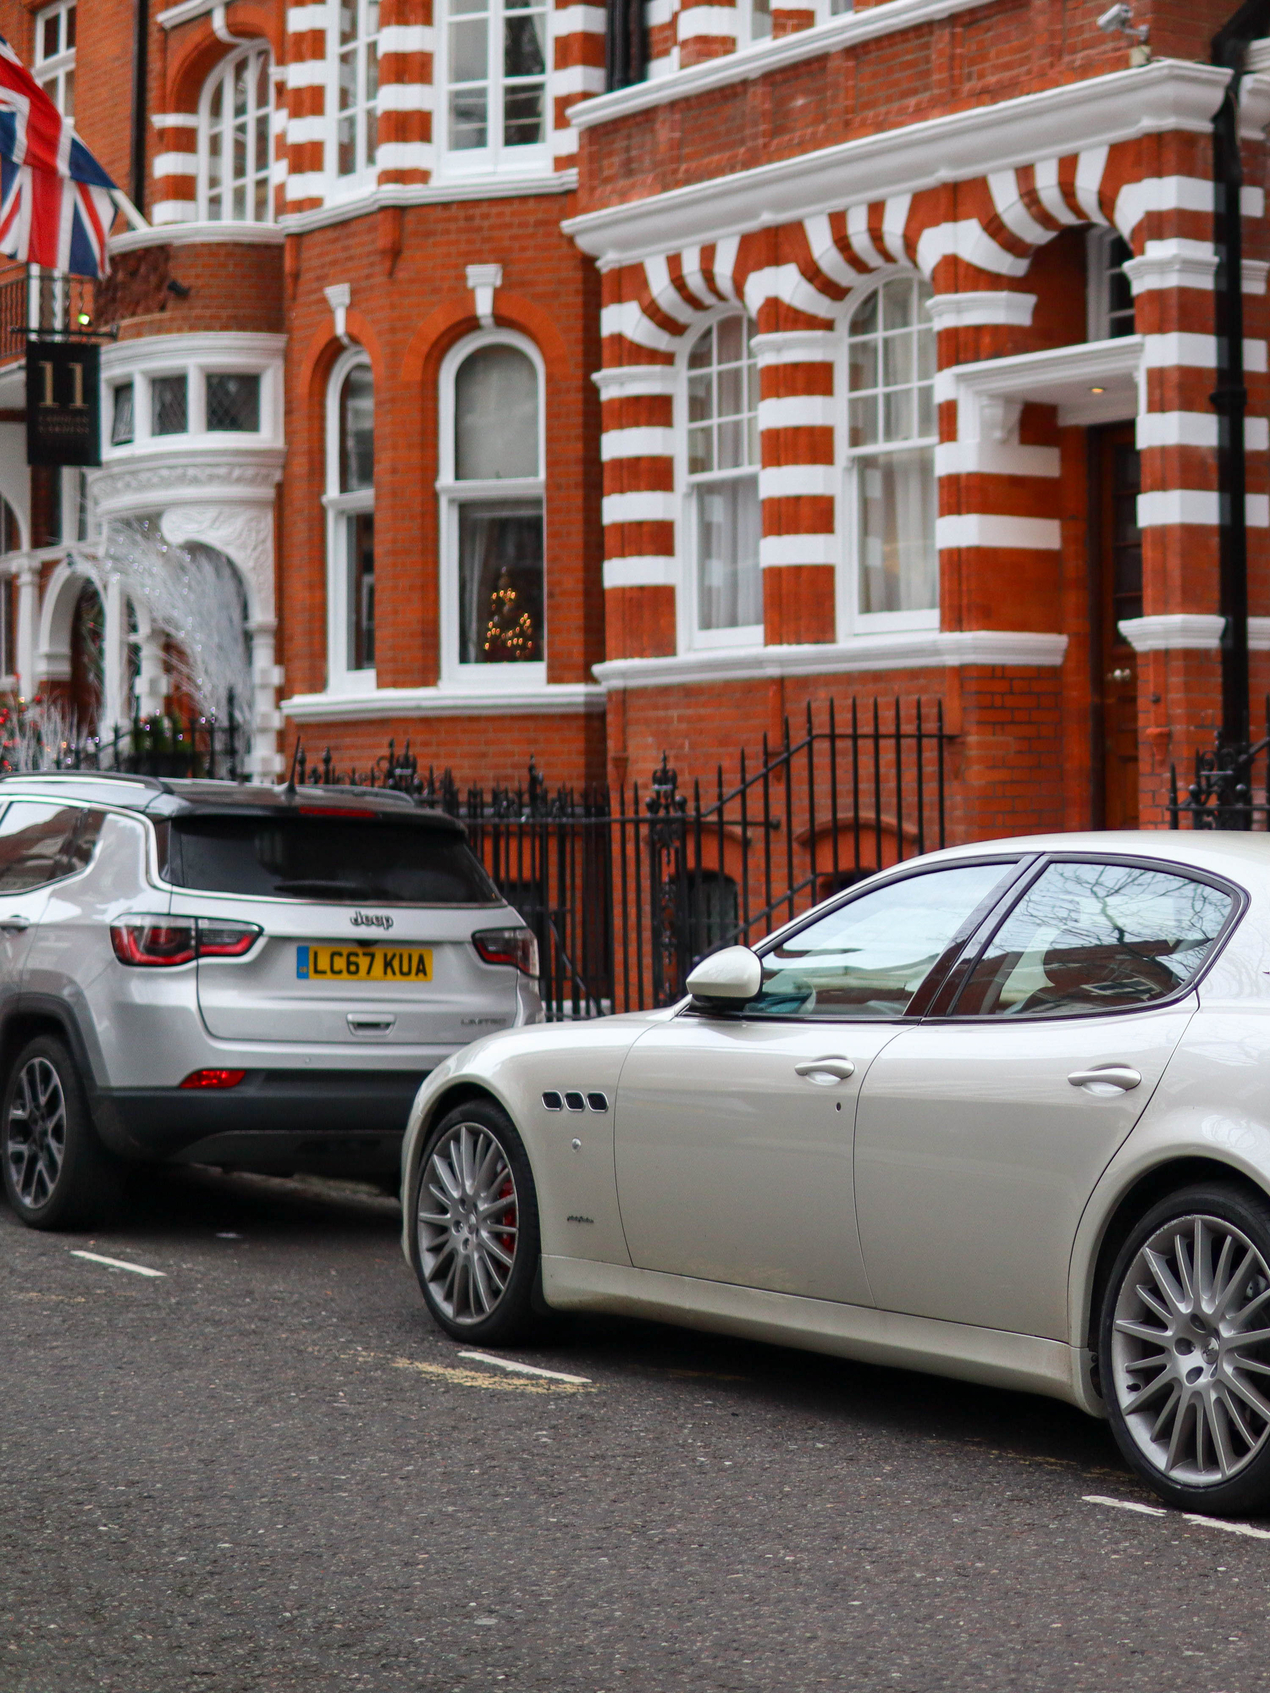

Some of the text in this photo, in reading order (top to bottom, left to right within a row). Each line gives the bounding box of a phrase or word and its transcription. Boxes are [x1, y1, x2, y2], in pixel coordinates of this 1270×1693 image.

[39, 361, 89, 409] 11
[350, 911, 394, 931] Jeep
[313, 950, 428, 977] LC67 KUA
